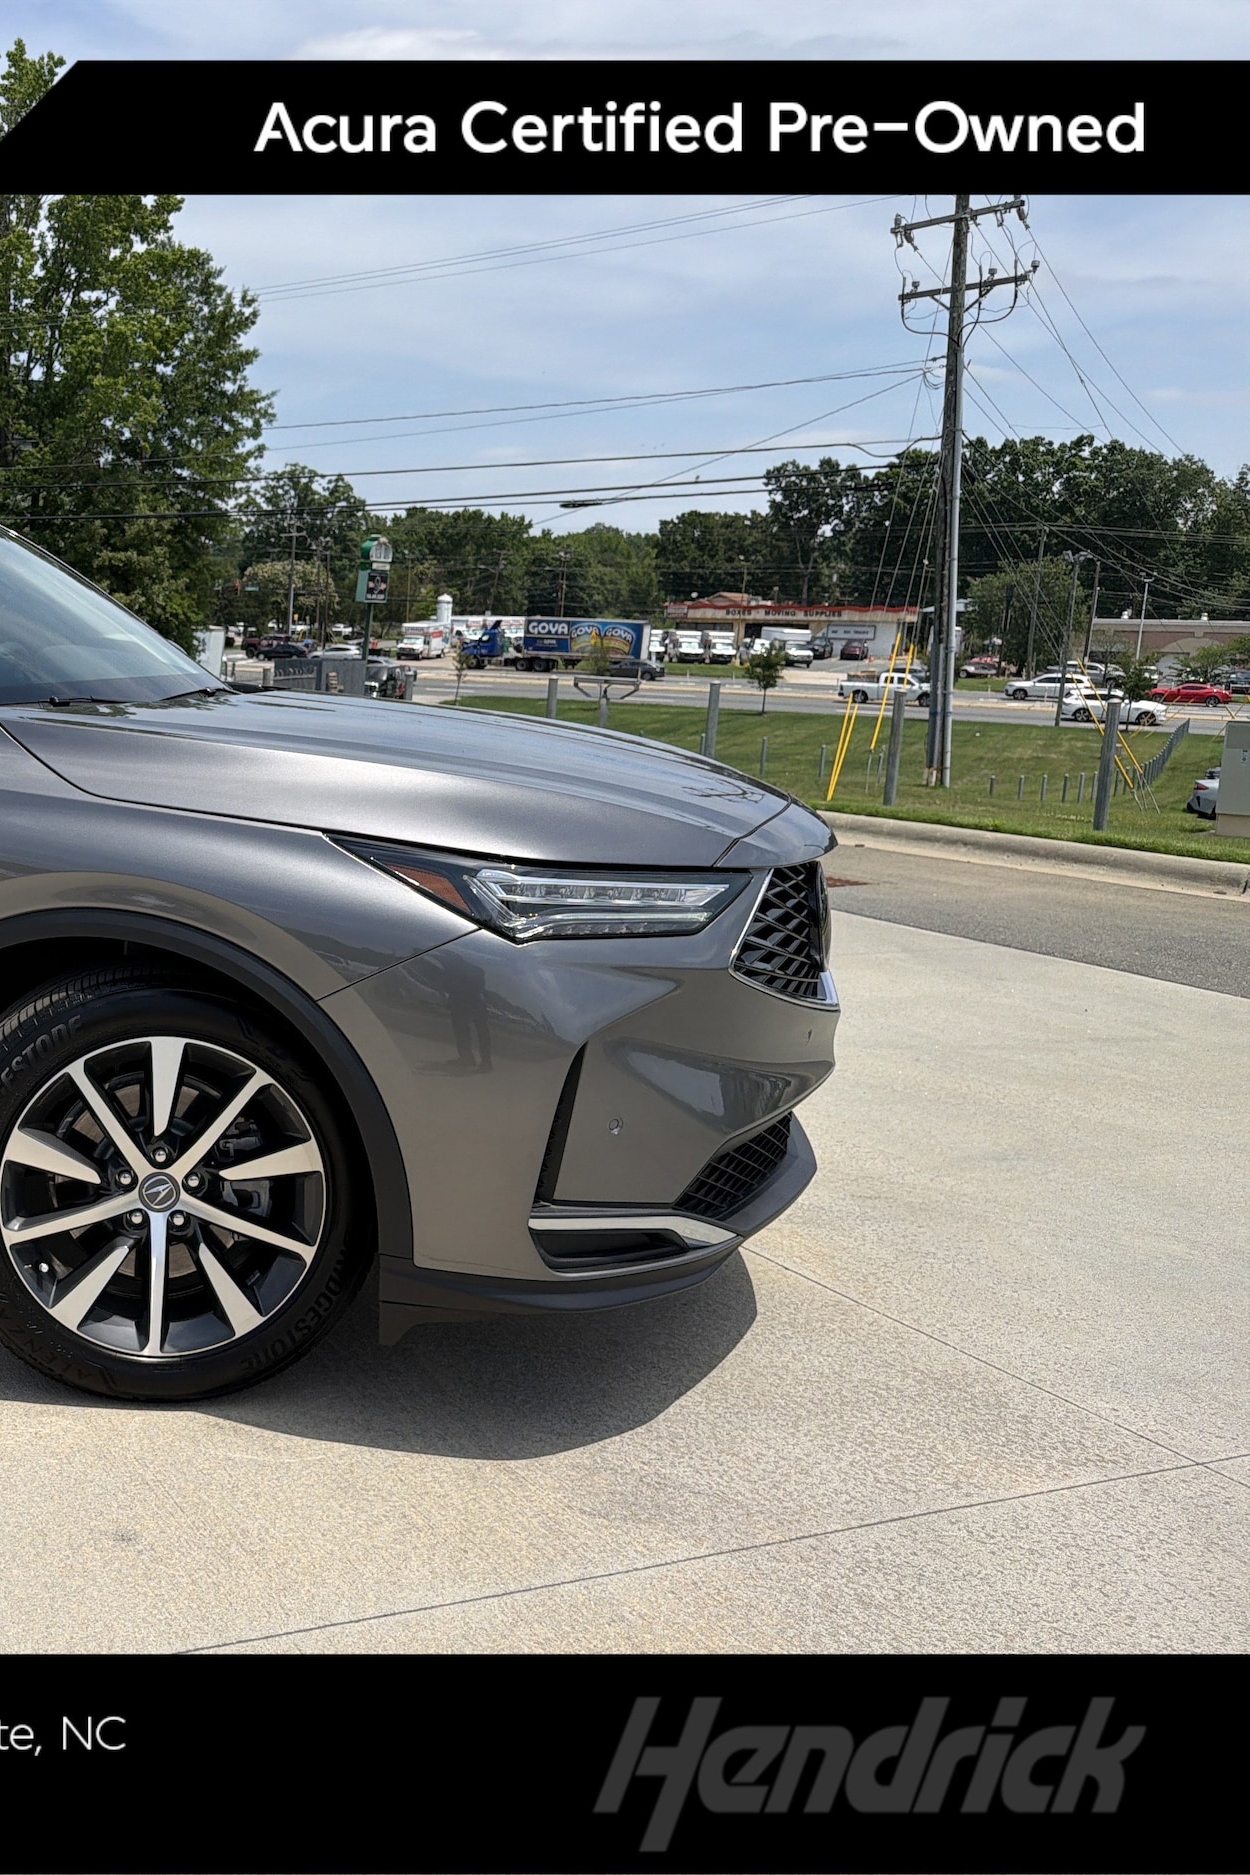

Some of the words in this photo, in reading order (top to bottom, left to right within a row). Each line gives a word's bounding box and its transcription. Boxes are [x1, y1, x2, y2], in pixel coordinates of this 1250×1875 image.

[725, 608, 752, 617] BOXES
[764, 609, 796, 618] MOVING
[803, 610, 843, 618] SUPPLIES
[528, 622, 569, 635] GOYA
[571, 626, 600, 638] GOYA
[605, 628, 633, 643] GOYA
